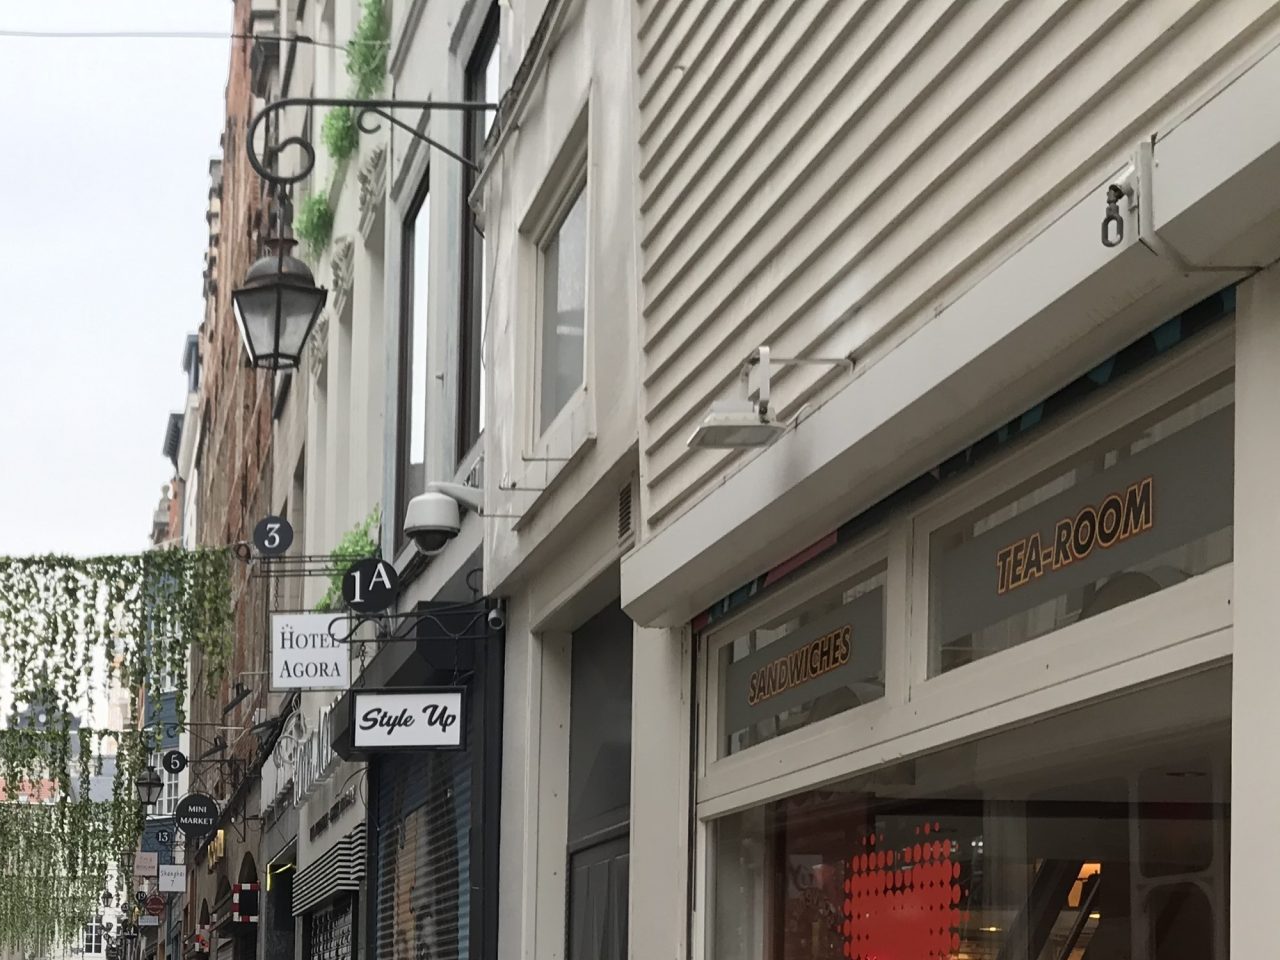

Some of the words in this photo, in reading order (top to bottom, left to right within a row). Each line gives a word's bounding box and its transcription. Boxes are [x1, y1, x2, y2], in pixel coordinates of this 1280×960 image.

[264, 523, 281, 548] 3
[996, 476, 1153, 596] TEA-ROOM
[350, 563, 392, 602] 1A
[280, 632, 341, 649] HOTEL
[280, 660, 341, 678] AGORA
[748, 624, 852, 706] SANDWICHES
[359, 707, 415, 735] Style
[422, 704, 456, 733] Up
[171, 754, 180, 770] 5
[180, 817, 214, 825] MARKET
[158, 832, 168, 842] 13
